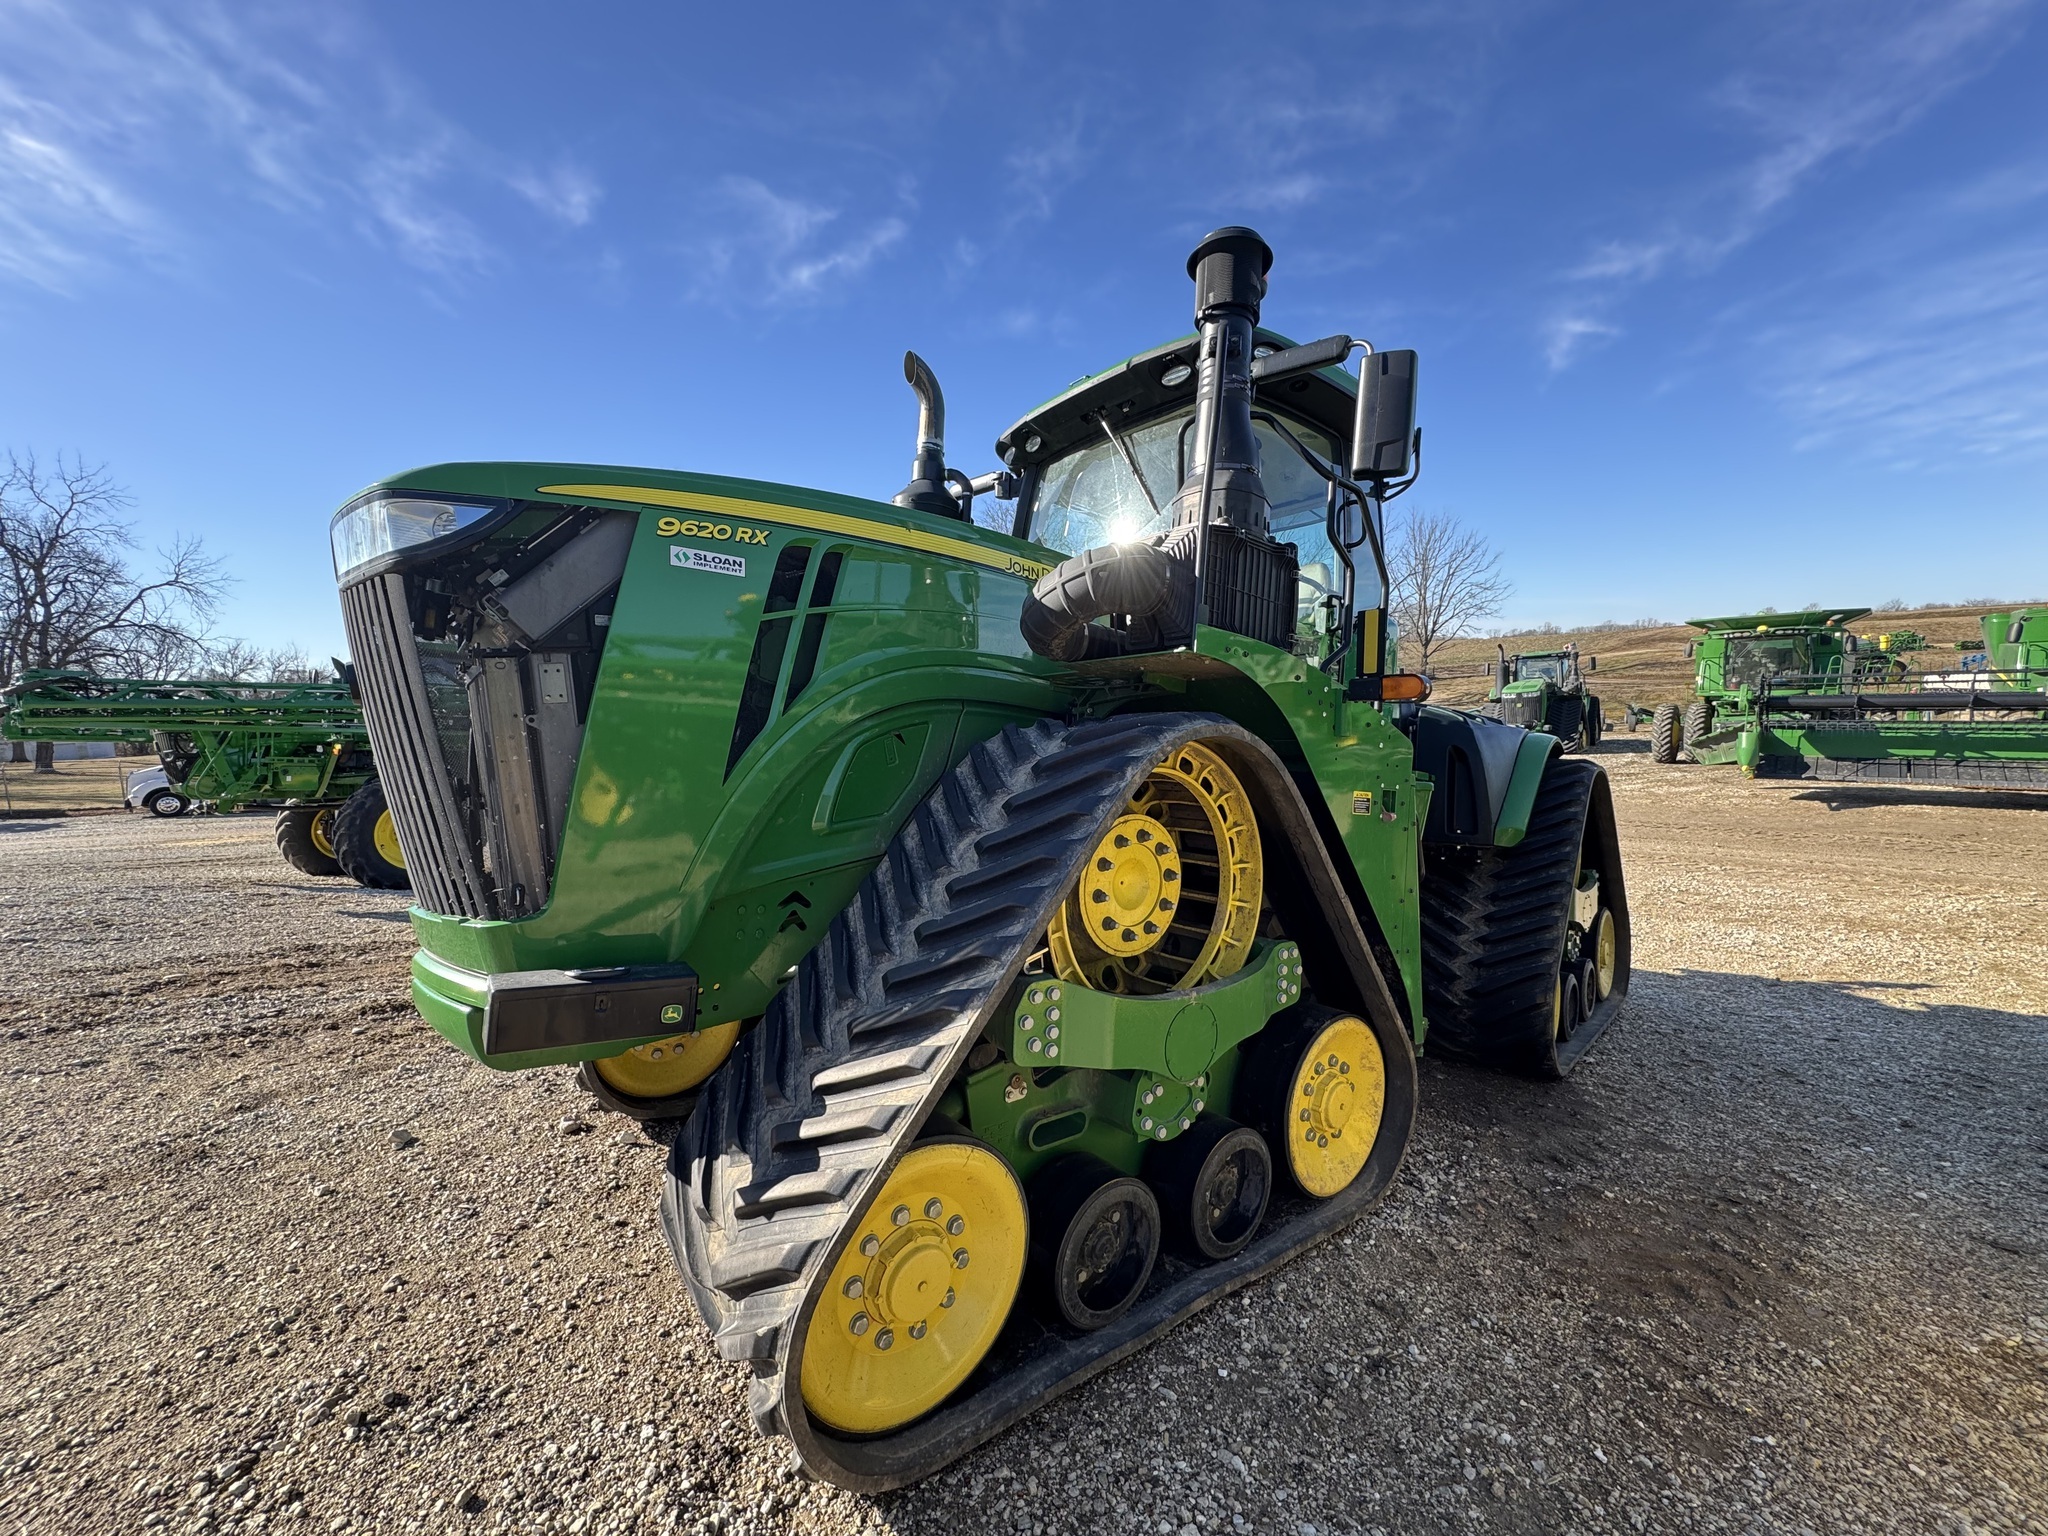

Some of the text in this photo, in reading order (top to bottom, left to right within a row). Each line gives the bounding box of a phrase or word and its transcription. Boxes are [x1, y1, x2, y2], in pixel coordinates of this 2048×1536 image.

[656, 516, 772, 546] 9620 RX
[692, 552, 743, 569] SLOAN
[692, 561, 743, 574] IMPLEMENT
[1004, 557, 1040, 579] JOHN
